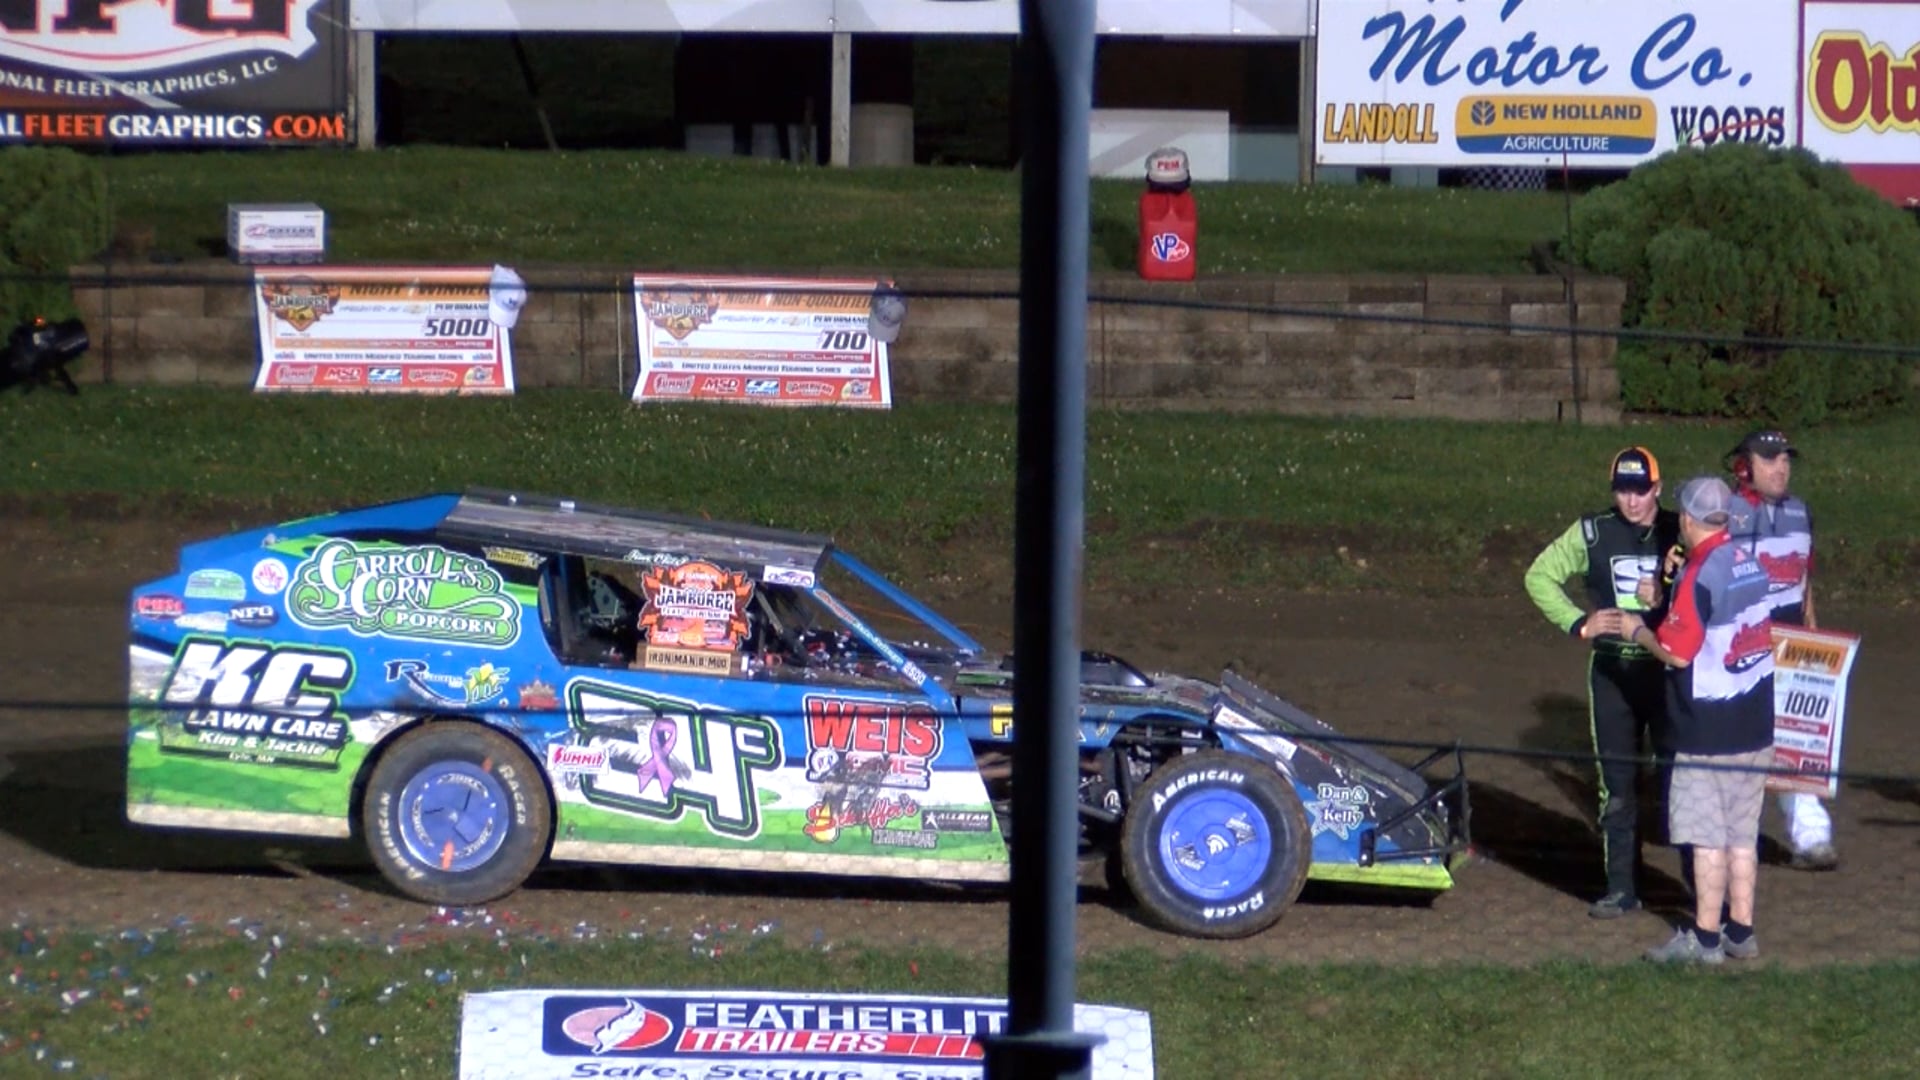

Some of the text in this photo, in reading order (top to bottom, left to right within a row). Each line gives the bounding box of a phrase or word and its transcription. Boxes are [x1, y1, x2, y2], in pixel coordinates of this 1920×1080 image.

[1362, 10, 1753, 91] Motor Co.
[54, 79, 114, 97] FLEET
[120, 68, 236, 97] GRAPHICS,
[241, 56, 279, 79] LLC
[1323, 102, 1439, 145] LANDOLL
[1503, 103, 1643, 120] NEW HOLLAND
[1670, 105, 1786, 146] WOODS
[1502, 136, 1610, 151] AGRICULTURE
[1153, 234, 1179, 261] VP
[424, 318, 489, 336] 5000
[821, 331, 868, 350] 700
[350, 571, 436, 618] CORN
[655, 587, 734, 613] JAMBOREE
[396, 611, 498, 635] POPCORN
[164, 642, 348, 717] KC
[1784, 690, 1830, 719] 1000
[187, 708, 343, 740] LAWN CARE
[809, 699, 939, 758] WEIS
[199, 730, 327, 756] Kim & Jackie
[553, 746, 603, 765] SUMMIT
[1152, 769, 1245, 814] AMERICAN
[1320, 786, 1364, 802] Dan &
[1322, 809, 1362, 828] Kelly
[1202, 890, 1265, 920] RACER
[684, 1002, 1009, 1036] FEATHERLIT
[690, 1030, 889, 1054] TRAILERS
